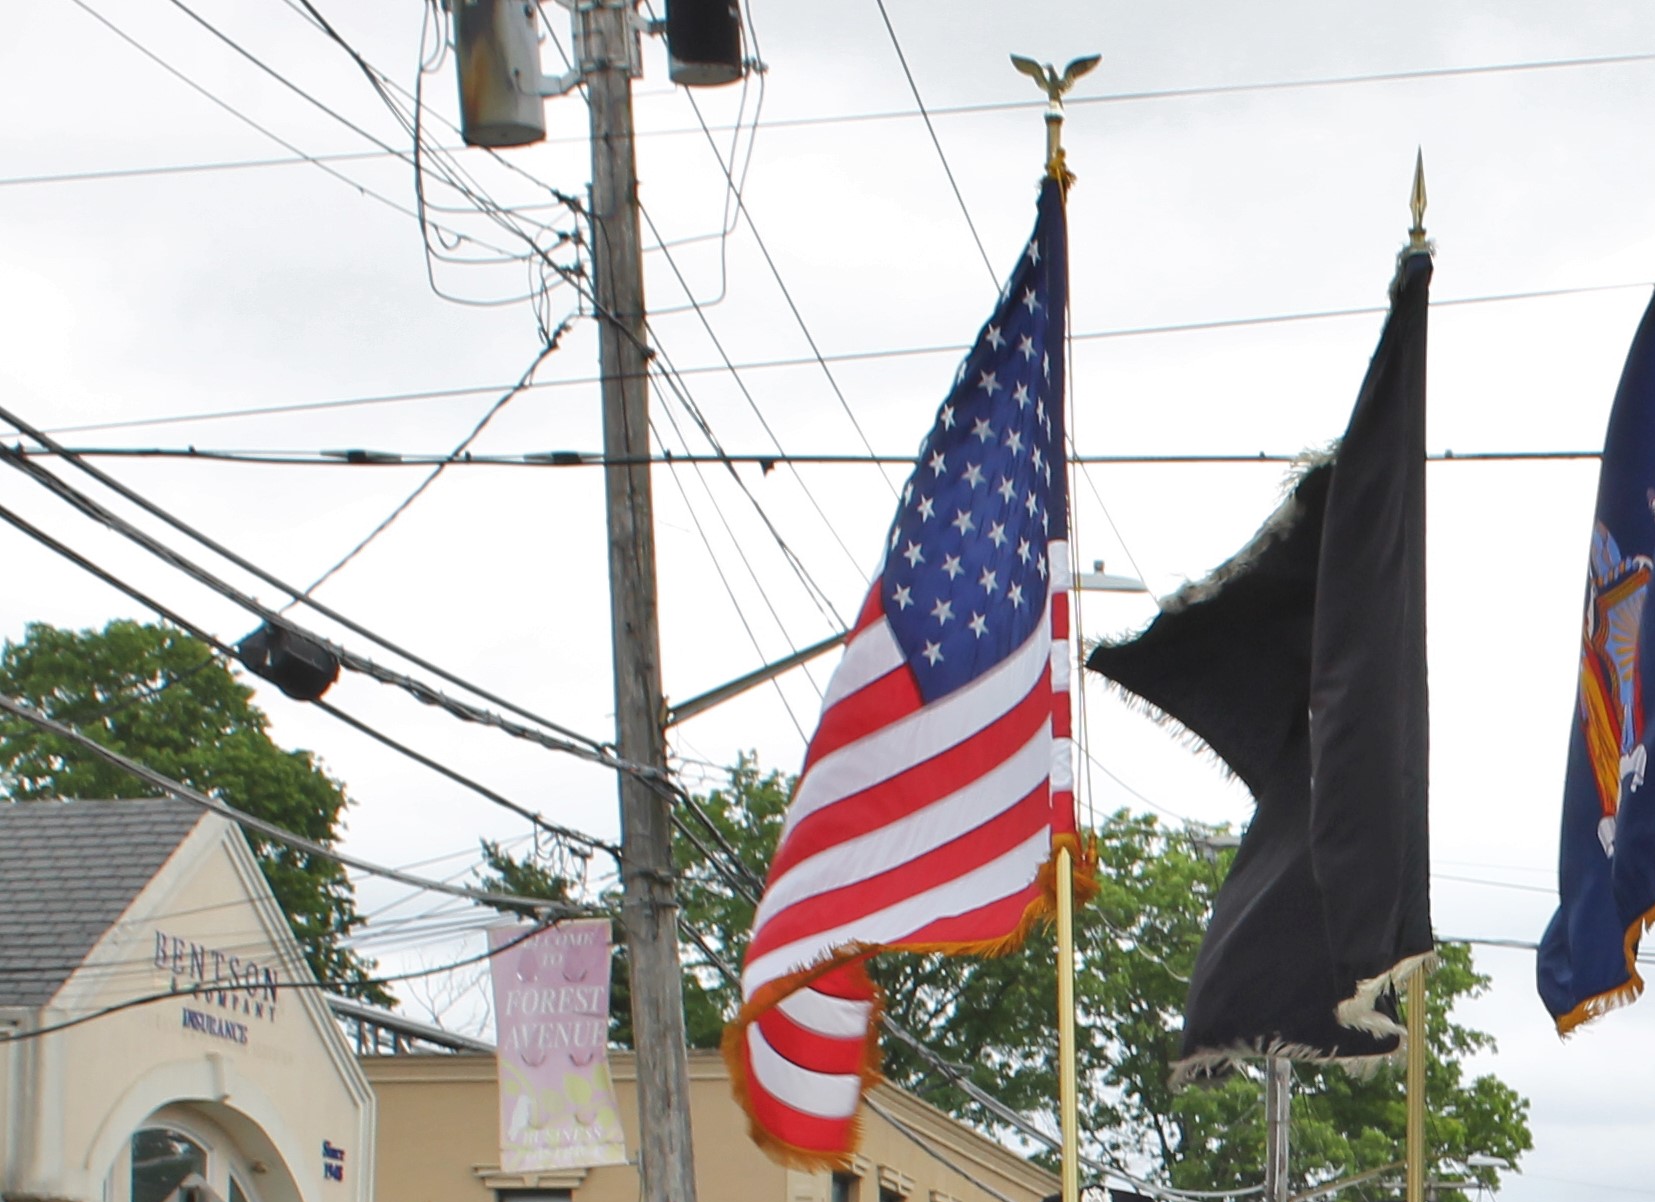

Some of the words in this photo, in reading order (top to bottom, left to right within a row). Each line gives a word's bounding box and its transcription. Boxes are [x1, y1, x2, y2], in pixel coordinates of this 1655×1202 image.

[155, 930, 277, 1003] BENTSON
[505, 985, 605, 1016] FOREST
[181, 1007, 249, 1045] INSURANCE
[504, 1020, 607, 1051] AVENUE
